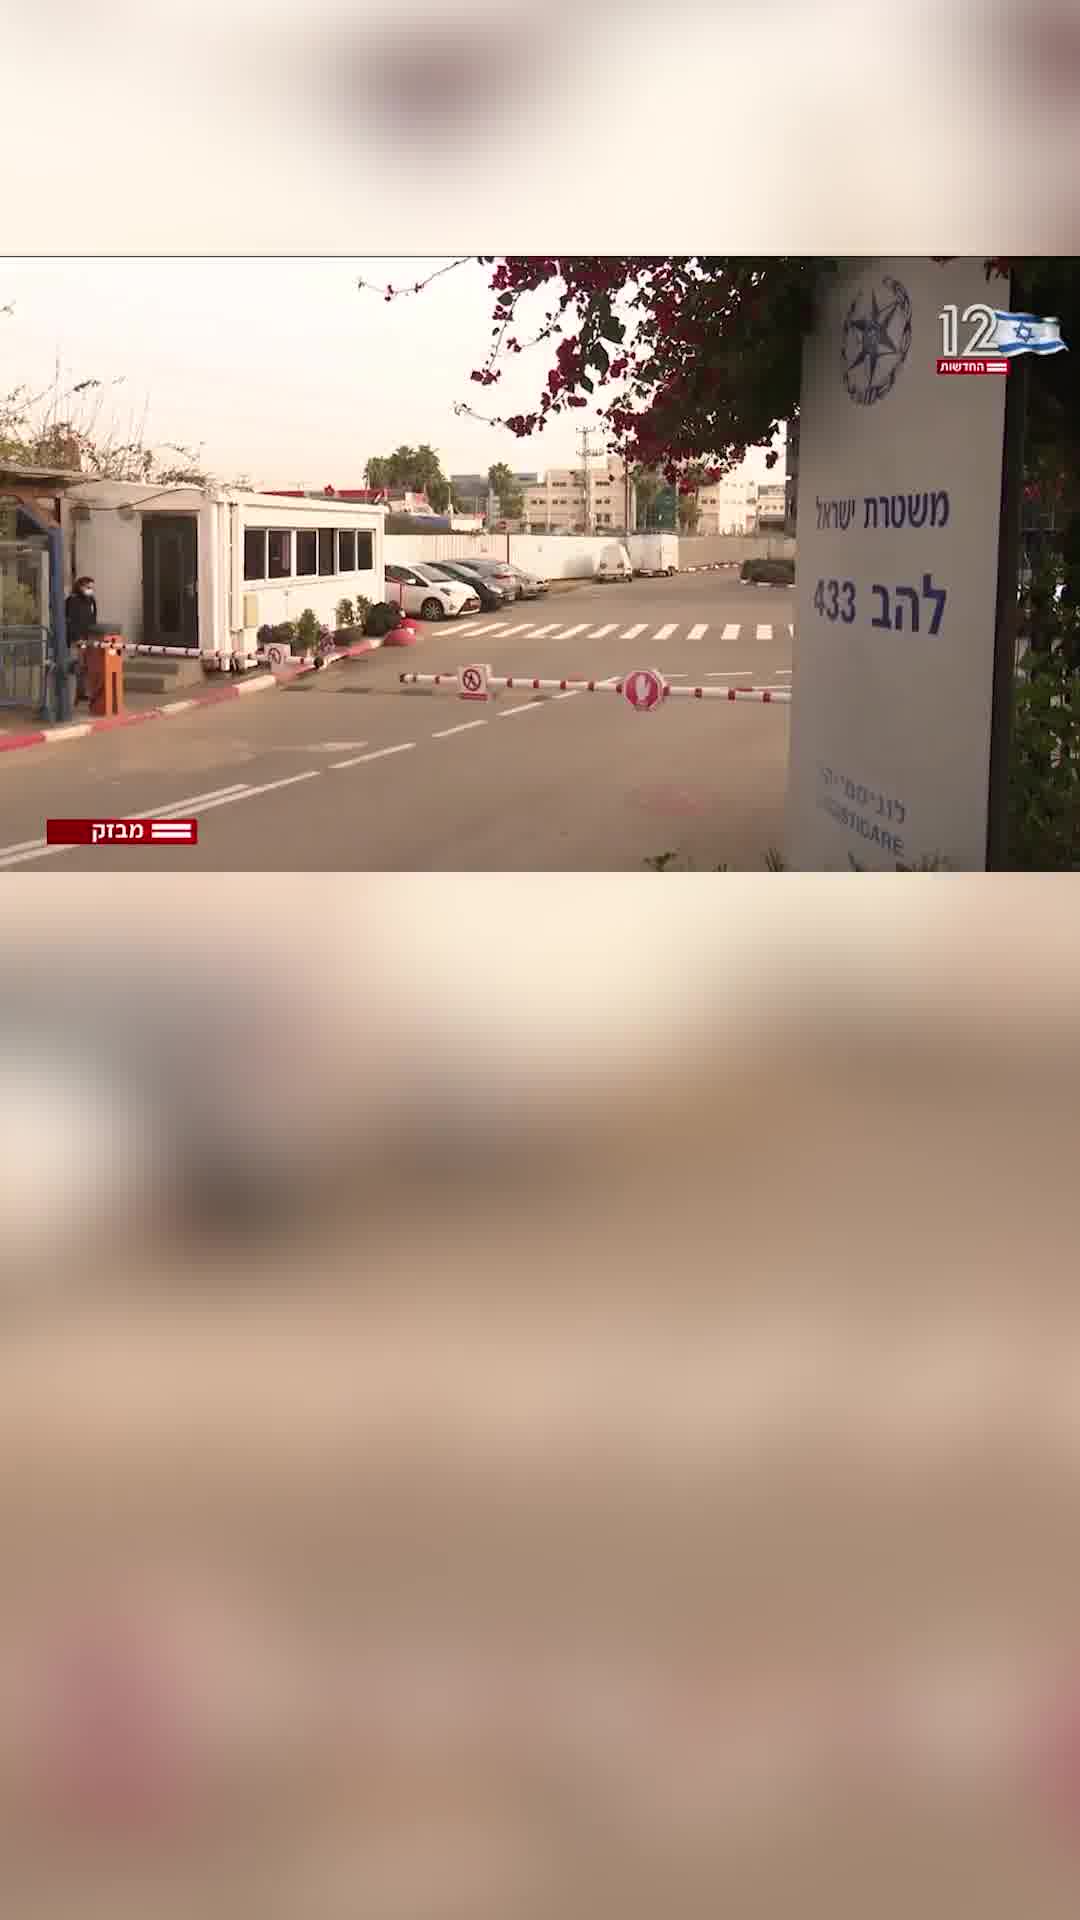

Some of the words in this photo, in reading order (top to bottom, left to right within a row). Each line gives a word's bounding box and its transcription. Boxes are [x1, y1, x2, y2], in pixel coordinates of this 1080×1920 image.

[815, 495, 856, 531] ישראל
[863, 490, 949, 529] משטרת
[814, 579, 856, 624] 433
[871, 573, 947, 635] להב
